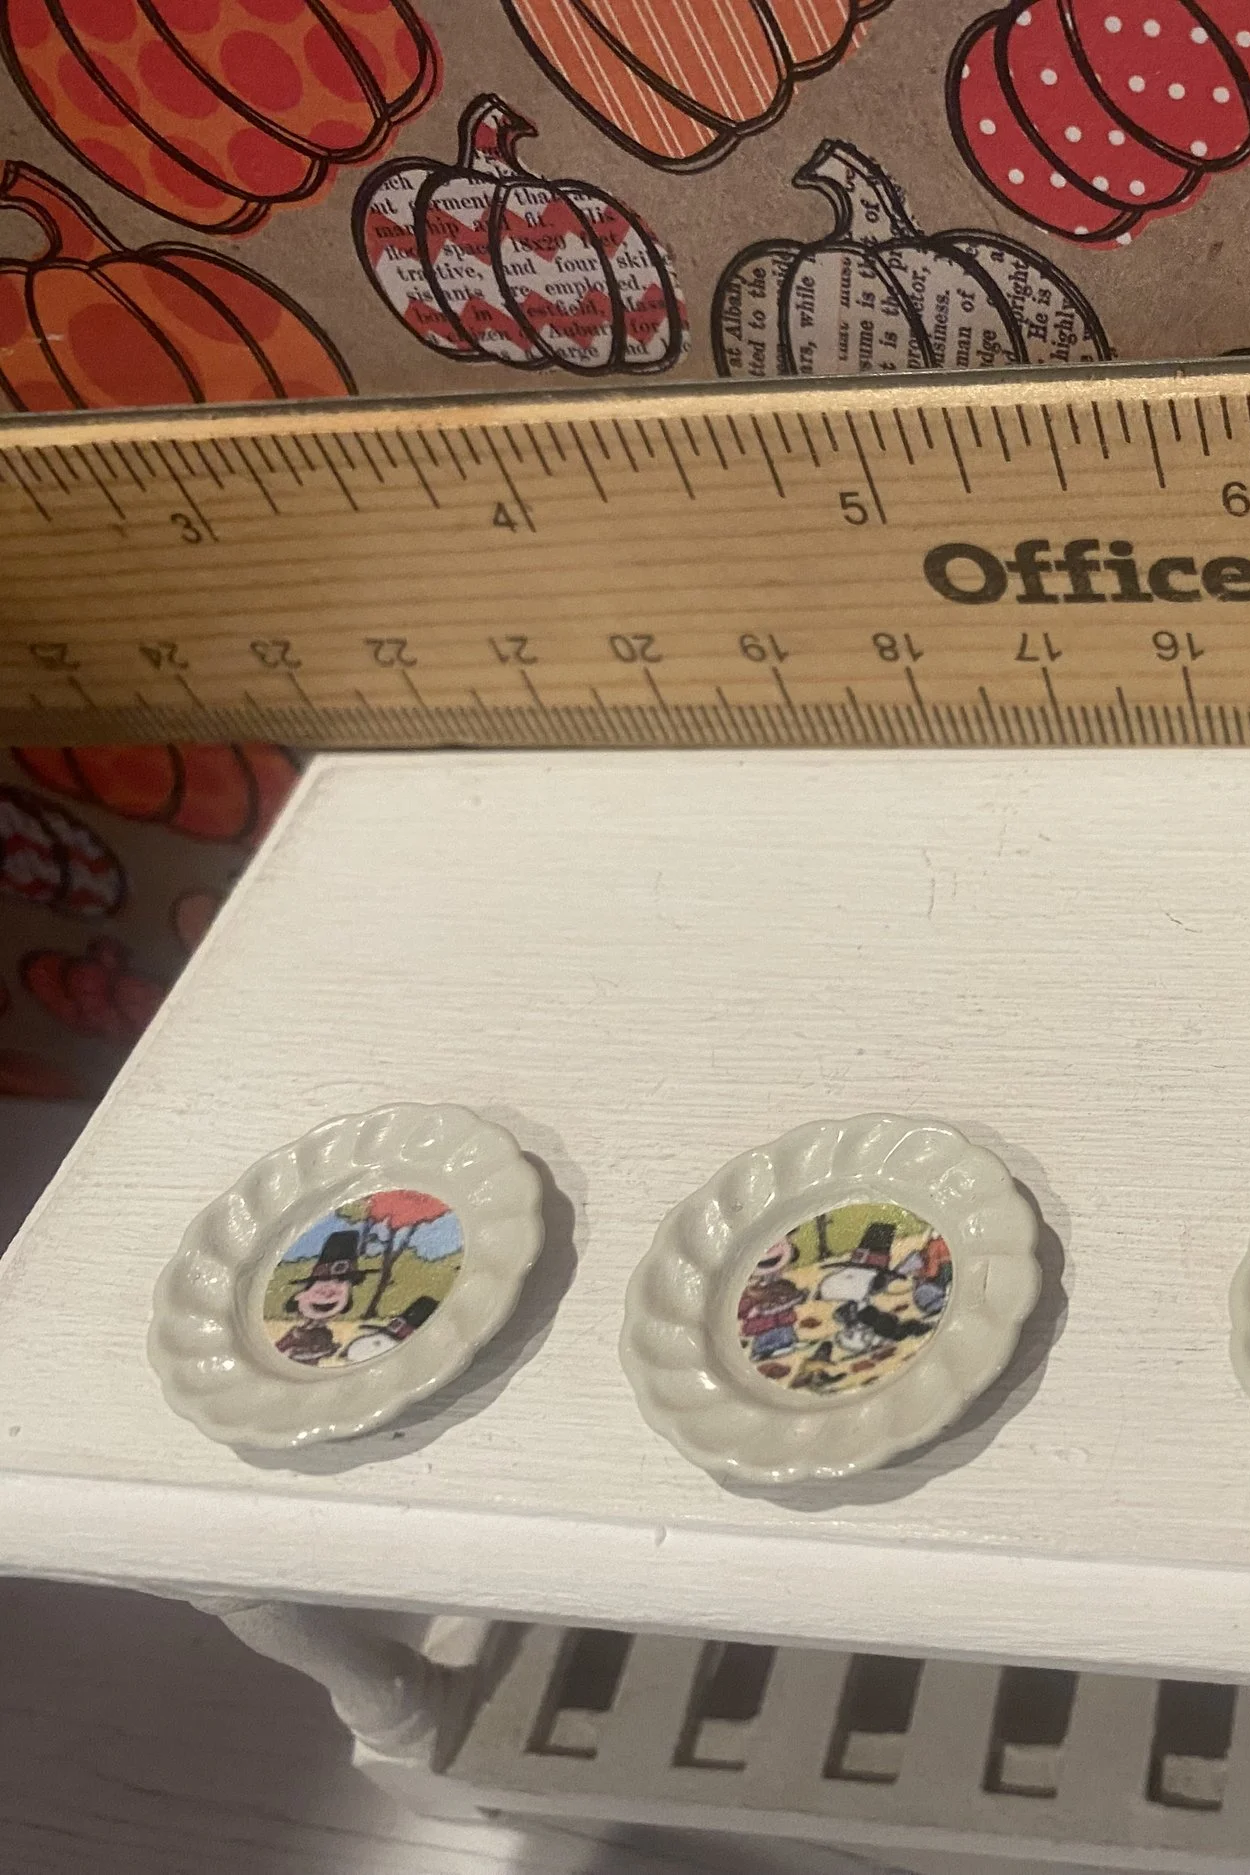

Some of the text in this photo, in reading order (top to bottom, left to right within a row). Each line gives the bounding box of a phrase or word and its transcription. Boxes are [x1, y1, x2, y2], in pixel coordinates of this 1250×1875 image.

[860, 198, 880, 224] of
[554, 256, 598, 274] four
[616, 251, 648, 269] ski
[544, 276, 646, 302] emploed.
[747, 266, 767, 299] the
[795, 275, 816, 329] while
[855, 291, 876, 310] is
[956, 288, 976, 313] of
[1026, 287, 1053, 344] He is
[748, 309, 766, 331] to
[928, 289, 951, 369] usiness.
[878, 331, 898, 350] is
[726, 346, 743, 369] at
[170, 511, 202, 545] 3
[491, 501, 518, 533] 4
[839, 491, 870, 526] 5
[249, 639, 302, 669] 23
[365, 637, 418, 667] 22
[488, 635, 538, 666] 21
[609, 634, 663, 665] 20
[739, 633, 789, 664] 19
[872, 632, 924, 663] 18
[1014, 632, 1063, 663] 17
[1152, 630, 1204, 662] 16
